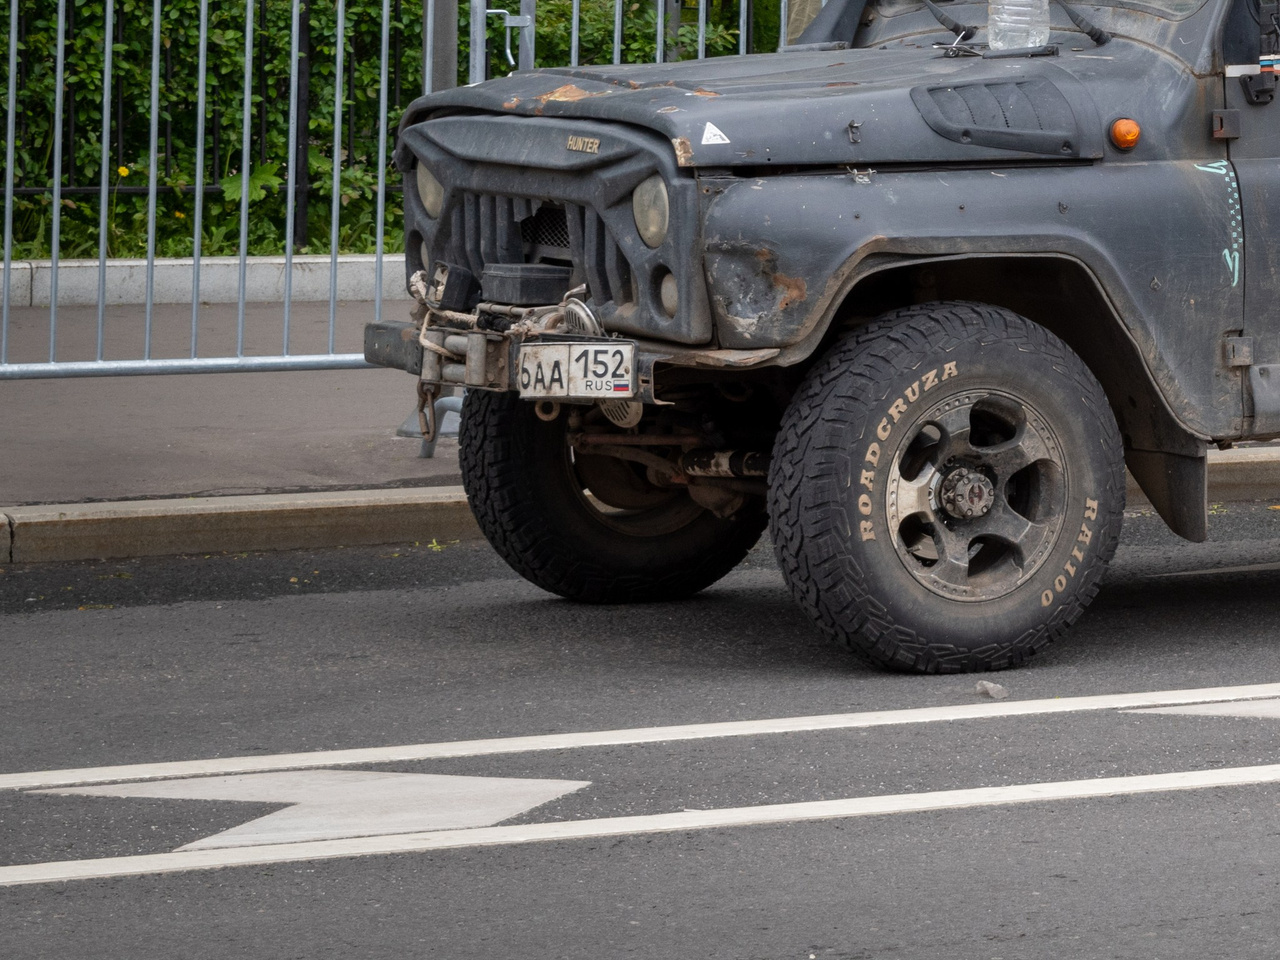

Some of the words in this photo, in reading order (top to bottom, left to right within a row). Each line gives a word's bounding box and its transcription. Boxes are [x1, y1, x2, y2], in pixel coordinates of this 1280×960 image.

[566, 134, 600, 154] HUNTER
[574, 349, 625, 379] 152
[585, 380, 612, 391] RUS
[858, 361, 959, 542] ROADCRUZA
